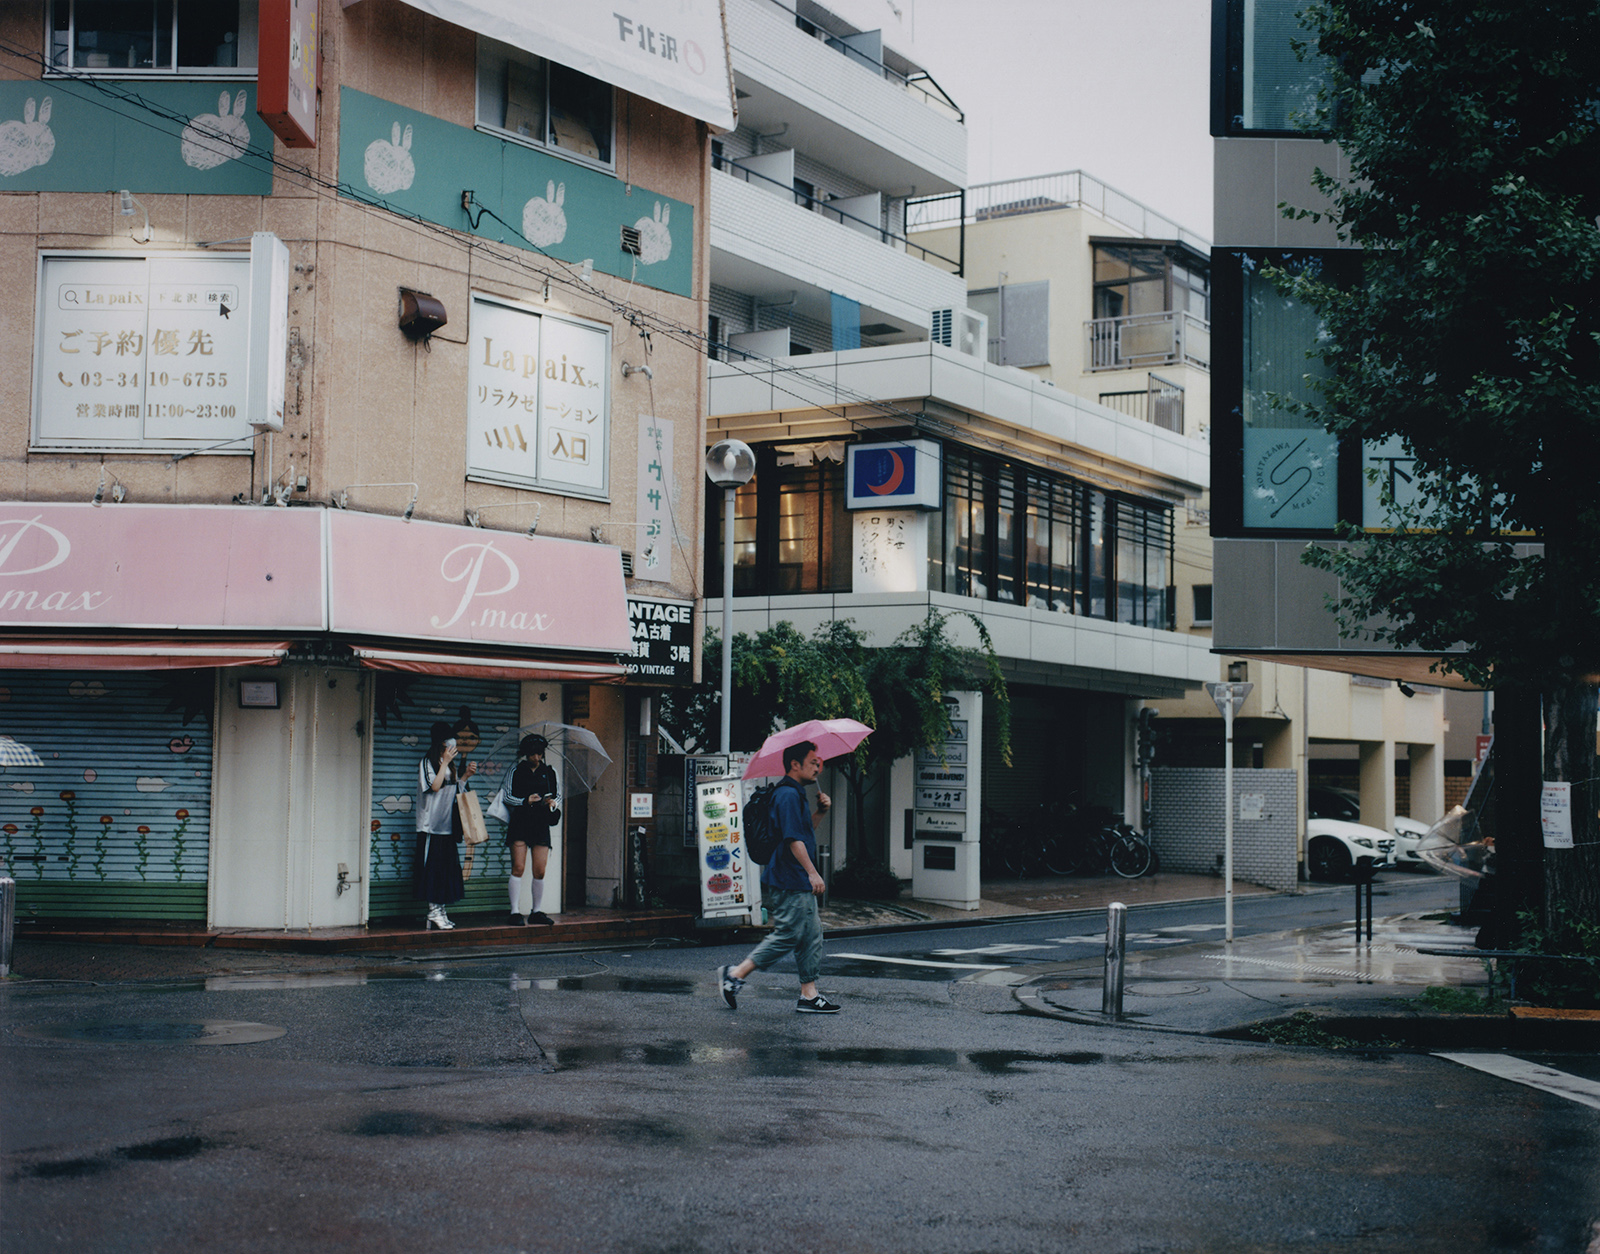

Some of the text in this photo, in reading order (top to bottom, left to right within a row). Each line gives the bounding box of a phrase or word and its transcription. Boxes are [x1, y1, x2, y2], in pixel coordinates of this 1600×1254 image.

[612, 12, 678, 63] 下北沢
[208, 292, 230, 303] 検索
[59, 328, 214, 356] ご予約優先
[80, 372, 228, 388] 03-3410-6755
[75, 403, 140, 418] 営業時間
[478, 384, 598, 424] リラクゼーション
[552, 432, 586, 462] 入口
[0, 514, 112, 611] Pmax
[430, 540, 555, 631] P.max
[628, 602, 690, 624] NTAGE
[670, 645, 690, 662] 3階
[640, 664, 675, 676] VINTAGE
[696, 765, 725, 776] 八千代ビル
[935, 792, 962, 801] シカゴ
[728, 802, 742, 873] コリほぐし
